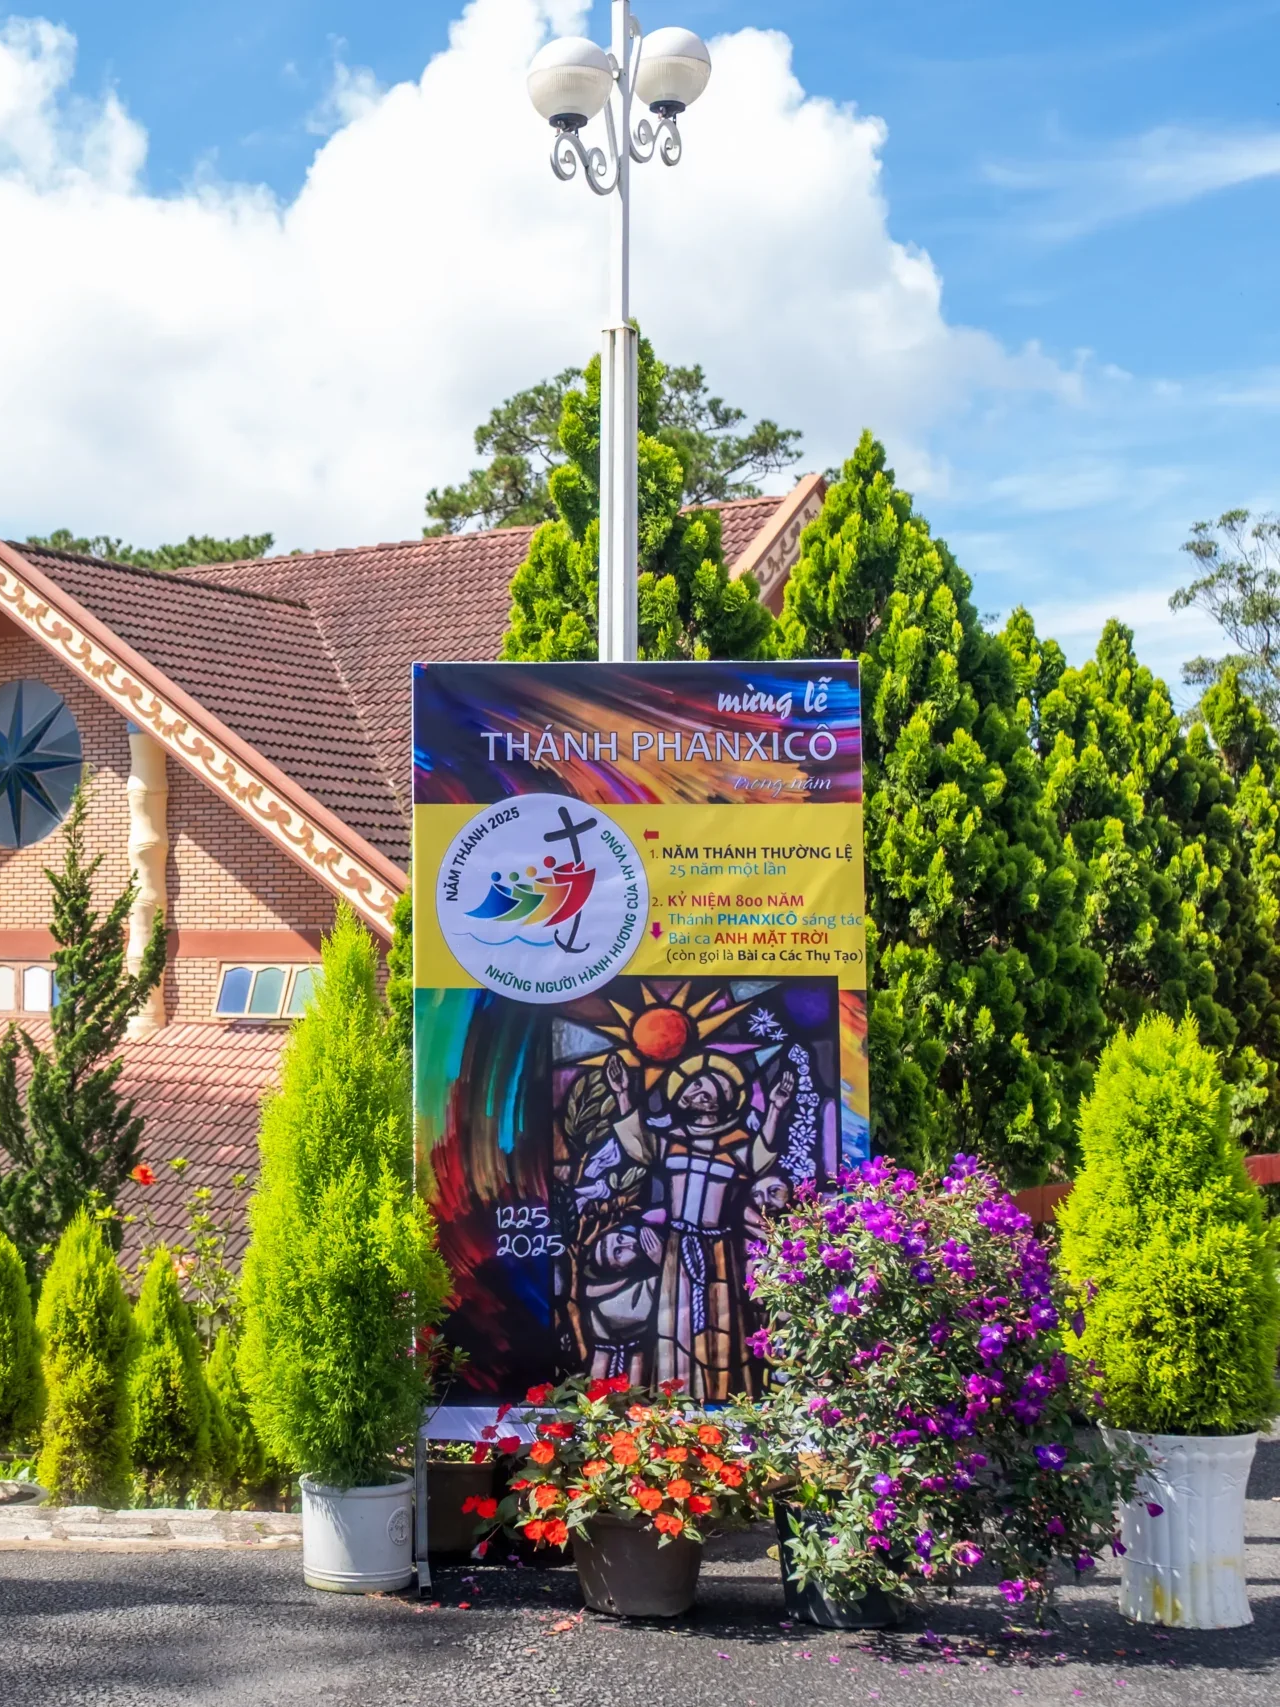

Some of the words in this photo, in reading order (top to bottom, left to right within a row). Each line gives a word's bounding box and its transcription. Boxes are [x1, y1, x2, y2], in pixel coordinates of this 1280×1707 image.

[717, 683, 794, 719] mừng
[803, 676, 833, 713] lễ
[480, 723, 618, 763] THÁNH
[632, 723, 838, 762] PHANXICÔ
[790, 775, 832, 790] năm
[443, 871, 461, 901] NĂM
[452, 823, 489, 868] THÁNH
[488, 806, 520, 830] 2025
[599, 829, 628, 864] VỌNG
[650, 849, 659, 859] 1.
[662, 844, 698, 859] NĂM
[702, 843, 757, 859] THÁNH
[760, 843, 831, 860] THƯỜNG
[835, 843, 853, 863] LỆ
[621, 863, 636, 881] HY
[669, 864, 686, 878] 25
[690, 863, 723, 875] năm
[727, 863, 758, 878] một
[762, 861, 786, 875] lần
[625, 883, 639, 908] CỦA
[651, 896, 663, 907] 2.
[667, 890, 687, 907] KỶ
[690, 891, 731, 912] NIỆM
[735, 894, 763, 907] 800
[767, 891, 804, 907] NĂM
[667, 912, 713, 926] Thánh
[717, 910, 797, 925] PHANXICÔ
[801, 912, 836, 929] sáng
[840, 912, 863, 925] tác
[612, 913, 637, 959] HƯƠNG
[668, 931, 690, 944] Bài
[694, 935, 711, 944] ca
[714, 931, 748, 944] ANH
[752, 930, 787, 948] MẶT
[790, 929, 828, 944] TRỜI
[666, 949, 696, 964] (còn
[699, 949, 719, 965] gọi
[722, 949, 734, 961] là
[737, 950, 758, 961] Bài
[761, 952, 776, 961] ca
[779, 950, 803, 961] Các
[807, 949, 831, 964] Thụ
[834, 949, 863, 964] Tạo)
[484, 964, 531, 992] NHỮNG
[578, 955, 614, 985] HÀNH
[535, 974, 578, 993] NGƯỜI
[495, 1206, 550, 1229] 1225
[496, 1233, 566, 1258] 2025
